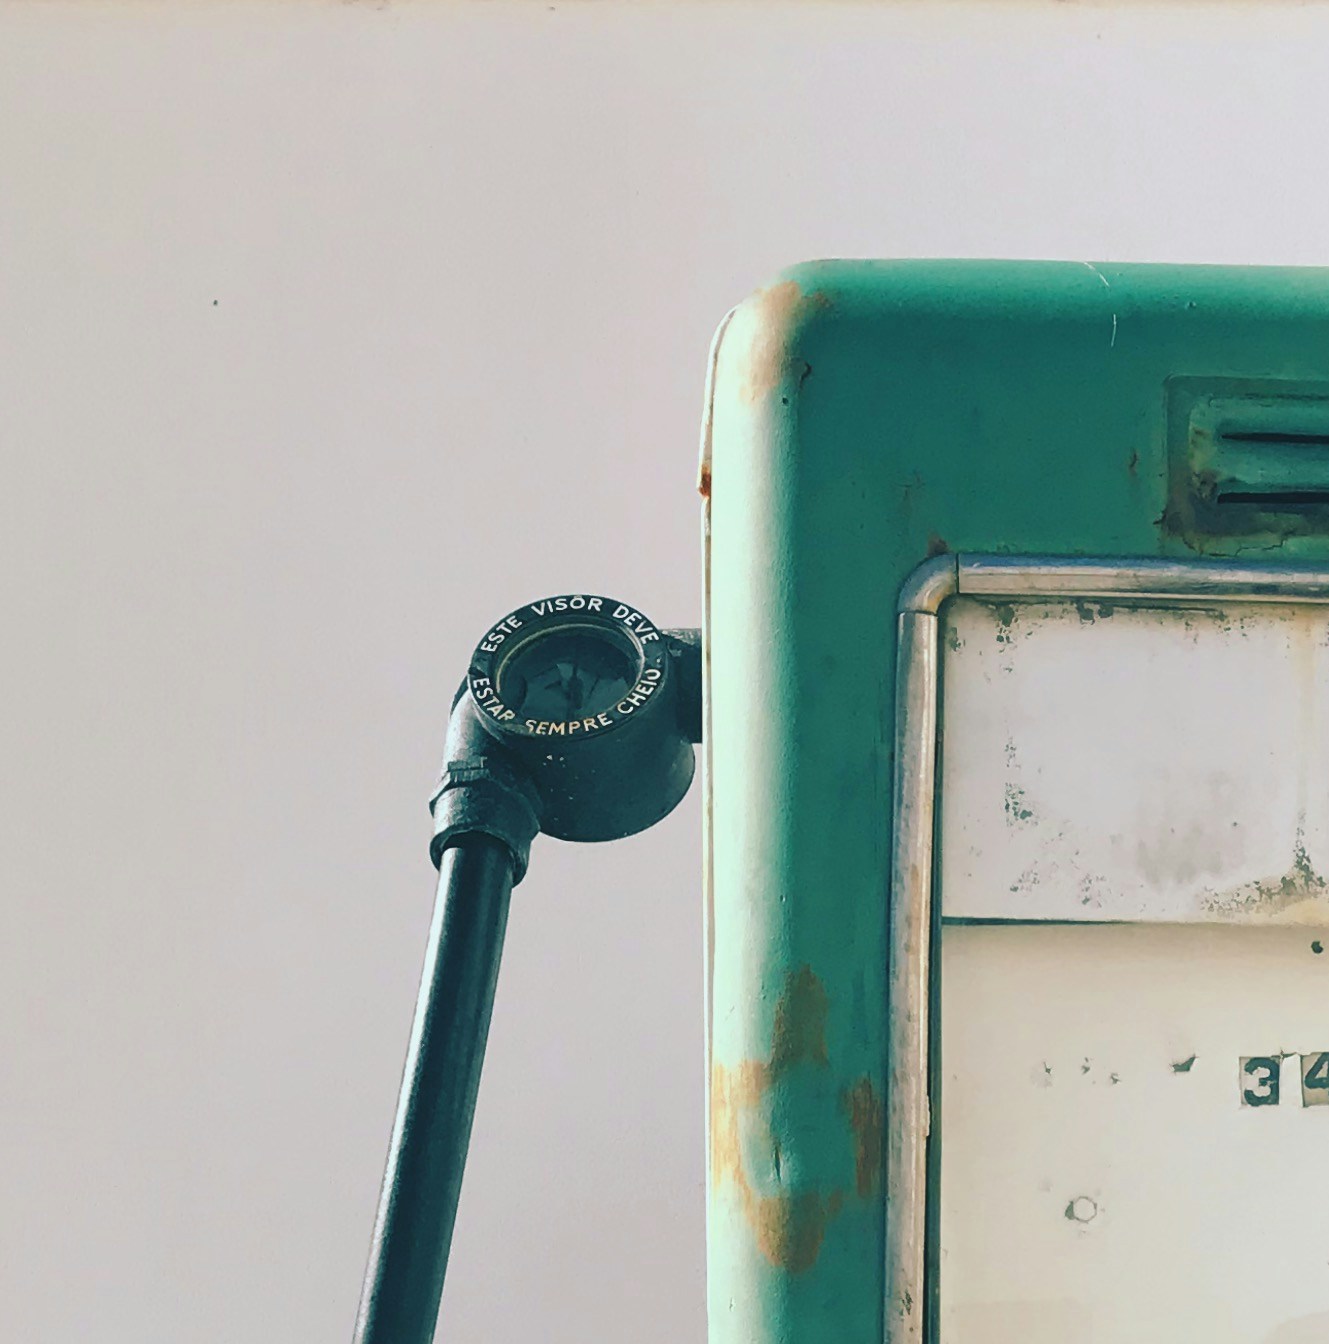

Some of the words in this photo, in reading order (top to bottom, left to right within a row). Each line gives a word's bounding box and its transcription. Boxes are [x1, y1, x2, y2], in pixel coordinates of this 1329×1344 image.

[480, 615, 523, 653] ESTE
[612, 604, 660, 645] DEVE
[473, 676, 516, 722] ESTAR
[525, 712, 614, 736] SEMPRE
[616, 668, 661, 714] CHEIO
